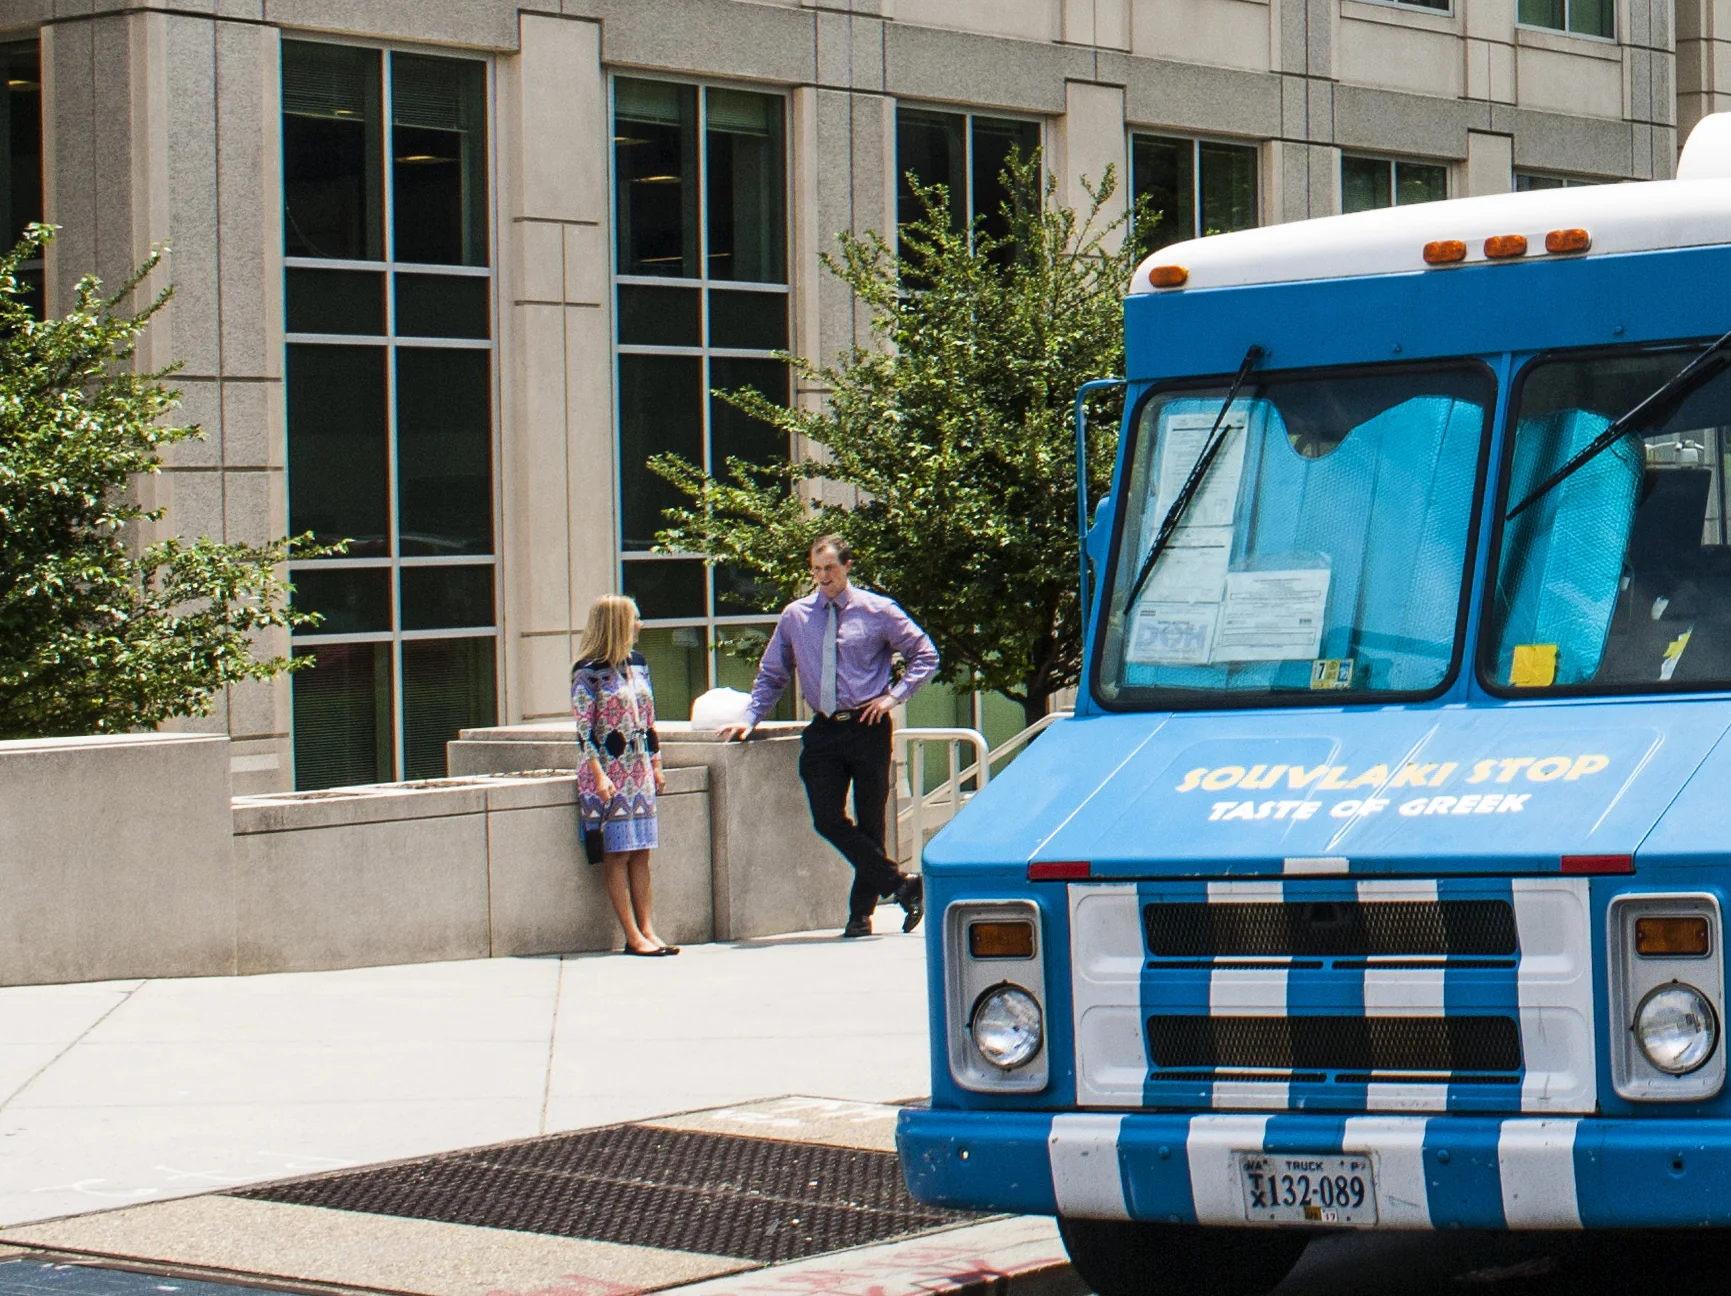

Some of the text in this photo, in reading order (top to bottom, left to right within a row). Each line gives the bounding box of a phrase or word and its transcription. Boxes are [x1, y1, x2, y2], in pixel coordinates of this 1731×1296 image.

[1175, 754, 1610, 793] SOUVLAKI STOP
[1207, 793, 1533, 822] TASTE OF GREEK
[1286, 1160, 1325, 1172] TRUCK
[1268, 1174, 1365, 1209] 132-089
